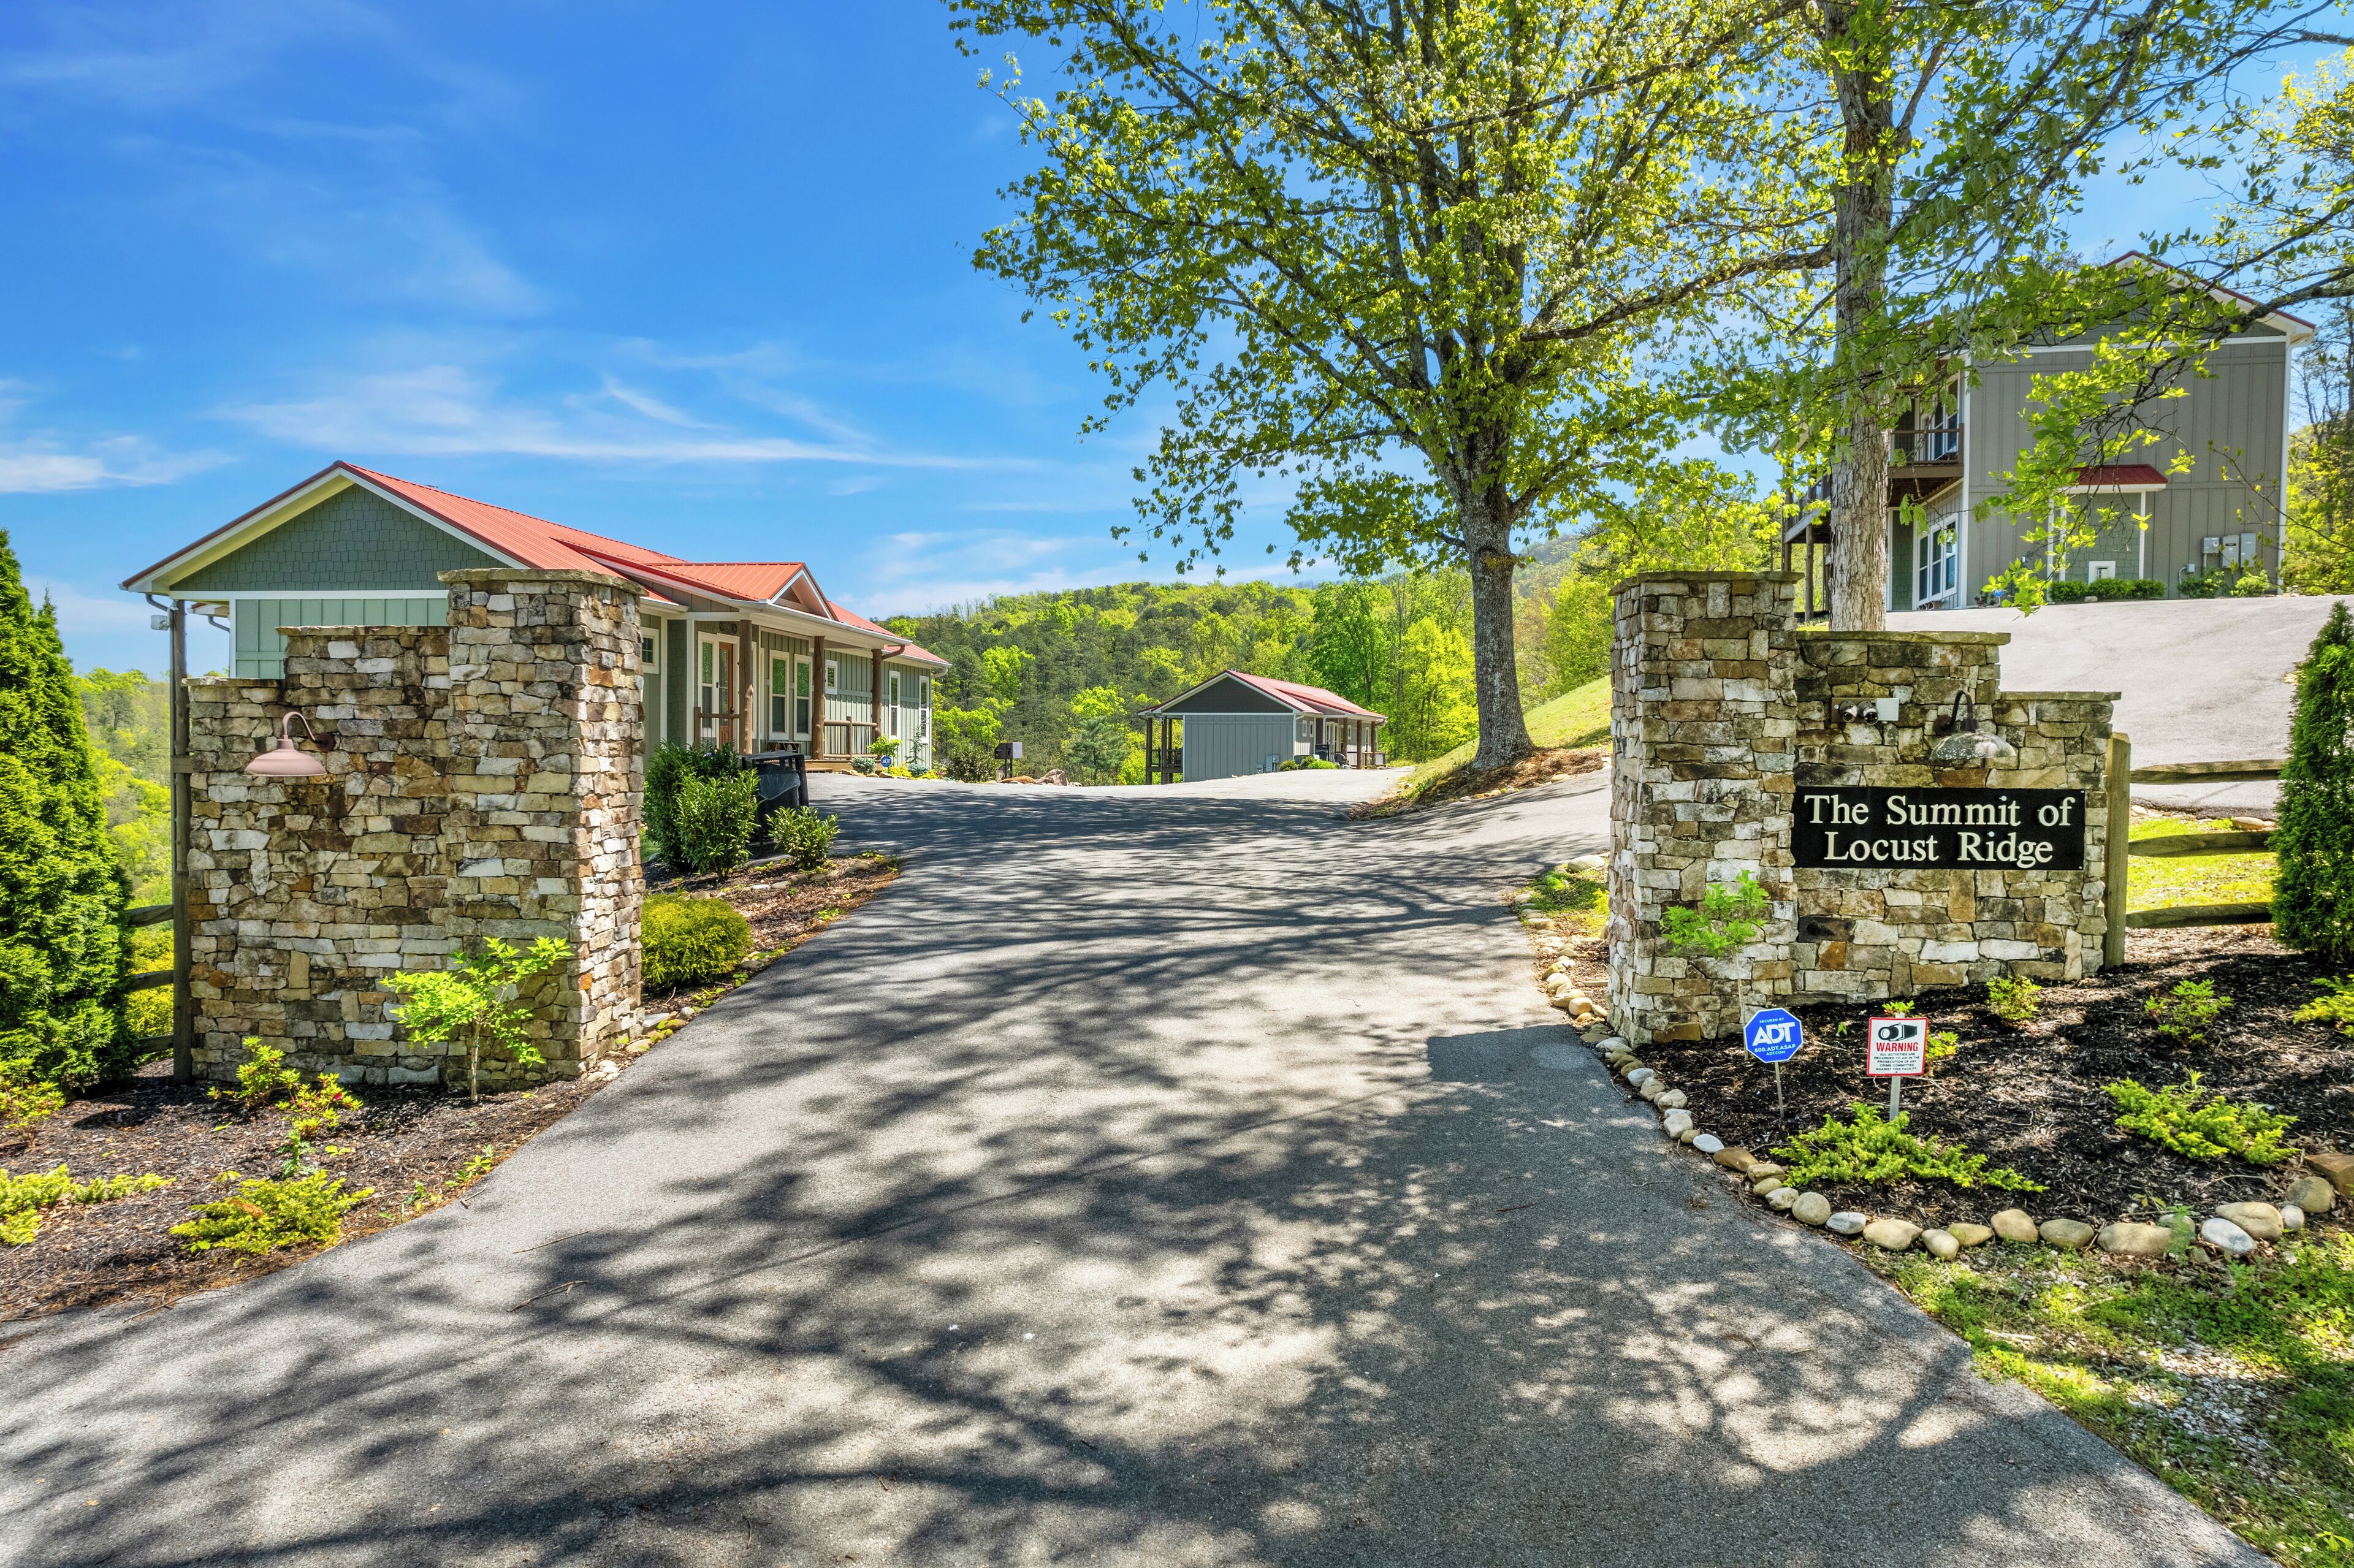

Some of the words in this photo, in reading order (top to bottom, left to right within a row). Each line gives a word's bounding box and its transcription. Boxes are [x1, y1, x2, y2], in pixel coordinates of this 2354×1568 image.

[1804, 794, 1869, 824] The
[1886, 794, 2021, 826] Summit
[2038, 797, 2076, 826] of
[1824, 831, 1940, 862] Locust
[1957, 831, 2054, 869] Ridge
[1752, 1022, 1796, 1046] ADT
[1754, 1044, 1796, 1052] 800.ADT.ASAP
[1876, 1042, 1918, 1052] WARNING
